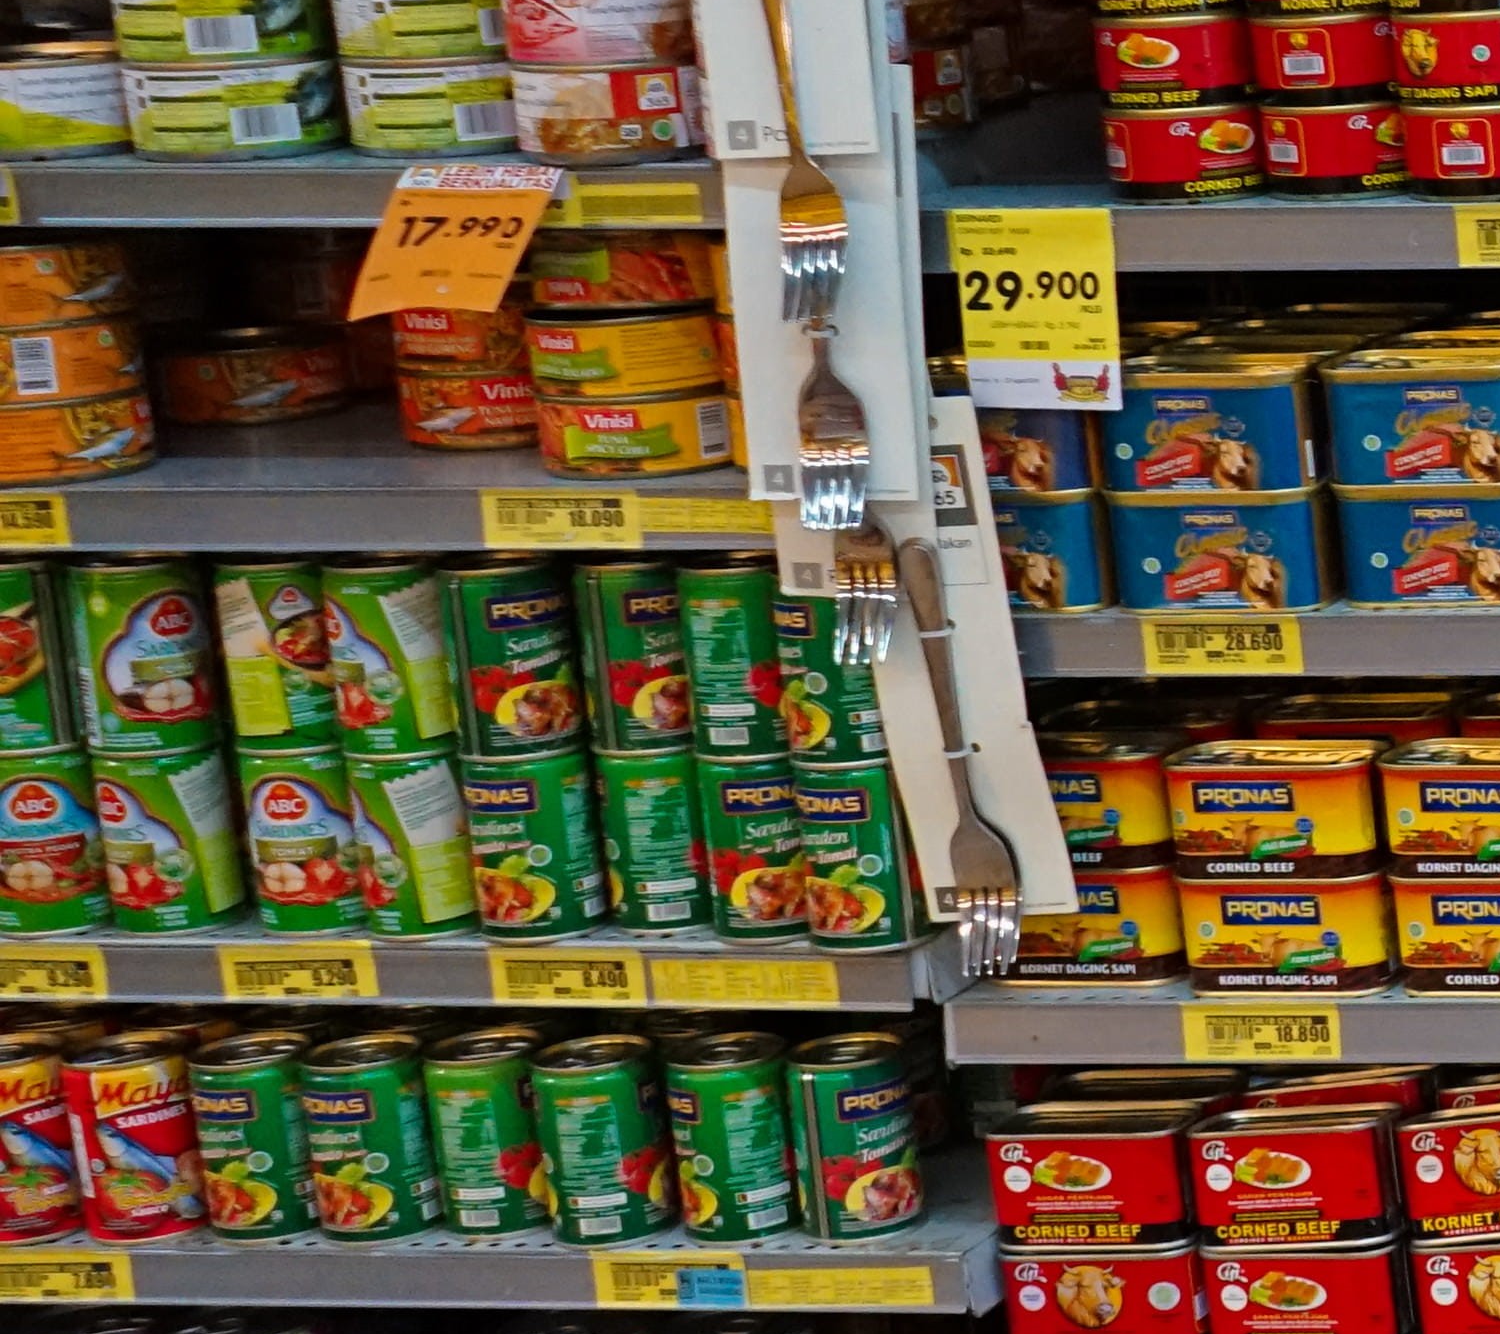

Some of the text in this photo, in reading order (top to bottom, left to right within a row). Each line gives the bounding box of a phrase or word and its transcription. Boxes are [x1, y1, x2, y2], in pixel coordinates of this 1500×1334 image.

[397, 215, 521, 248] 17.990
[966, 270, 1099, 309] 29.900
[584, 413, 634, 430] Vinisi
[1199, 786, 1288, 806] PRONAS
[269, 799, 302, 813] ABC
[1276, 1027, 1330, 1046] 18.890
